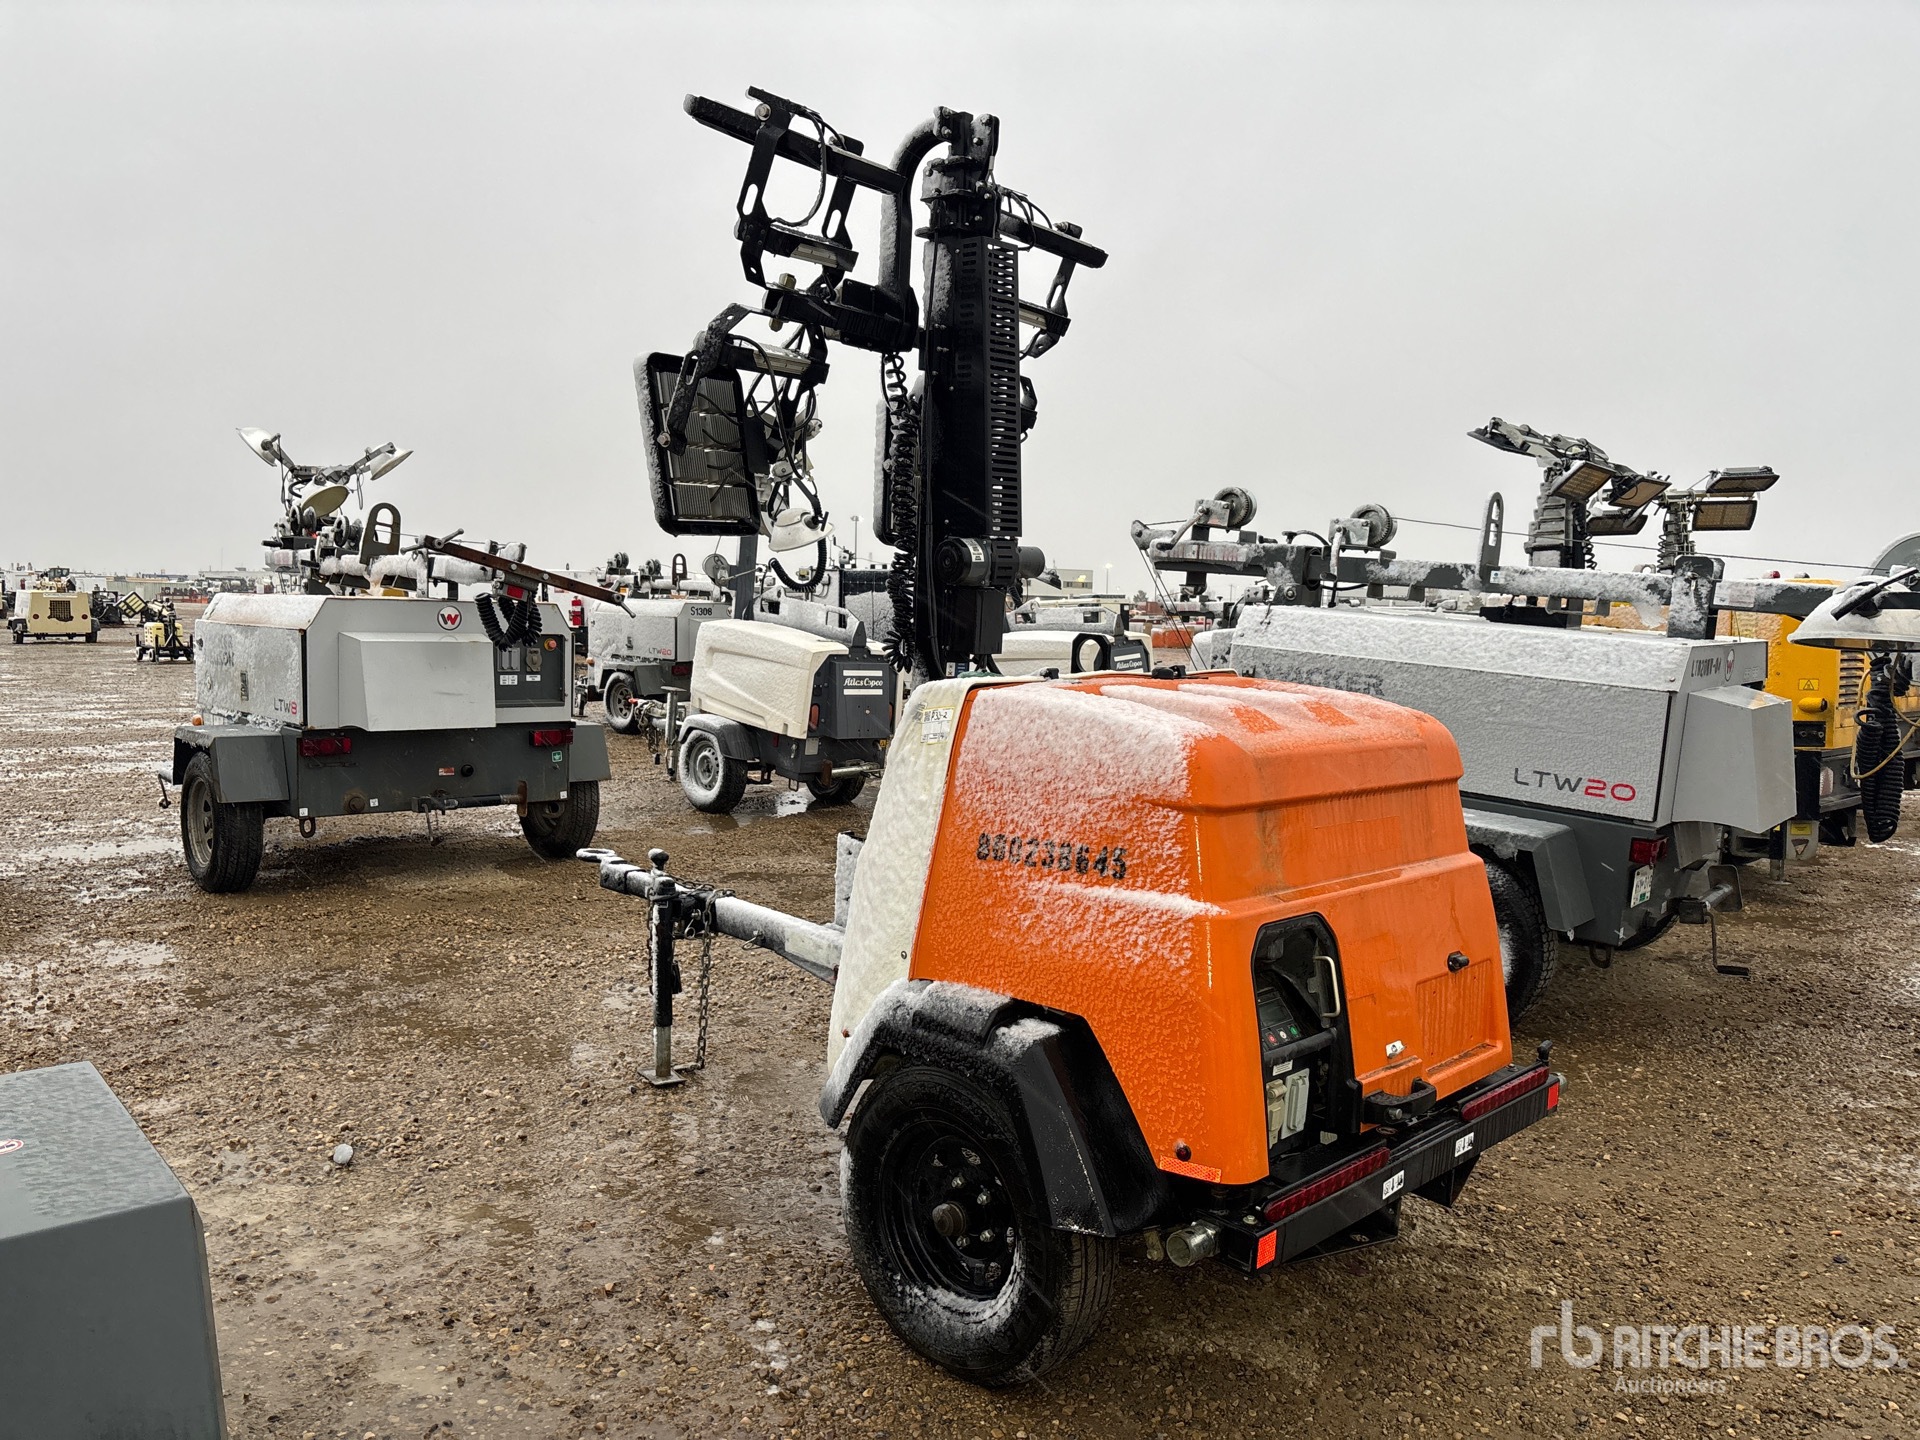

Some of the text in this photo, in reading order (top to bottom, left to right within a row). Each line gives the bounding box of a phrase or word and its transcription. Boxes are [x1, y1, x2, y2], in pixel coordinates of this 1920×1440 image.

[690, 607, 712, 616] S1308
[648, 648, 672, 656] LTW20
[843, 677, 883, 688] Atlas Copco
[273, 698, 297, 715] LTW8
[1513, 767, 1637, 802] LTW20
